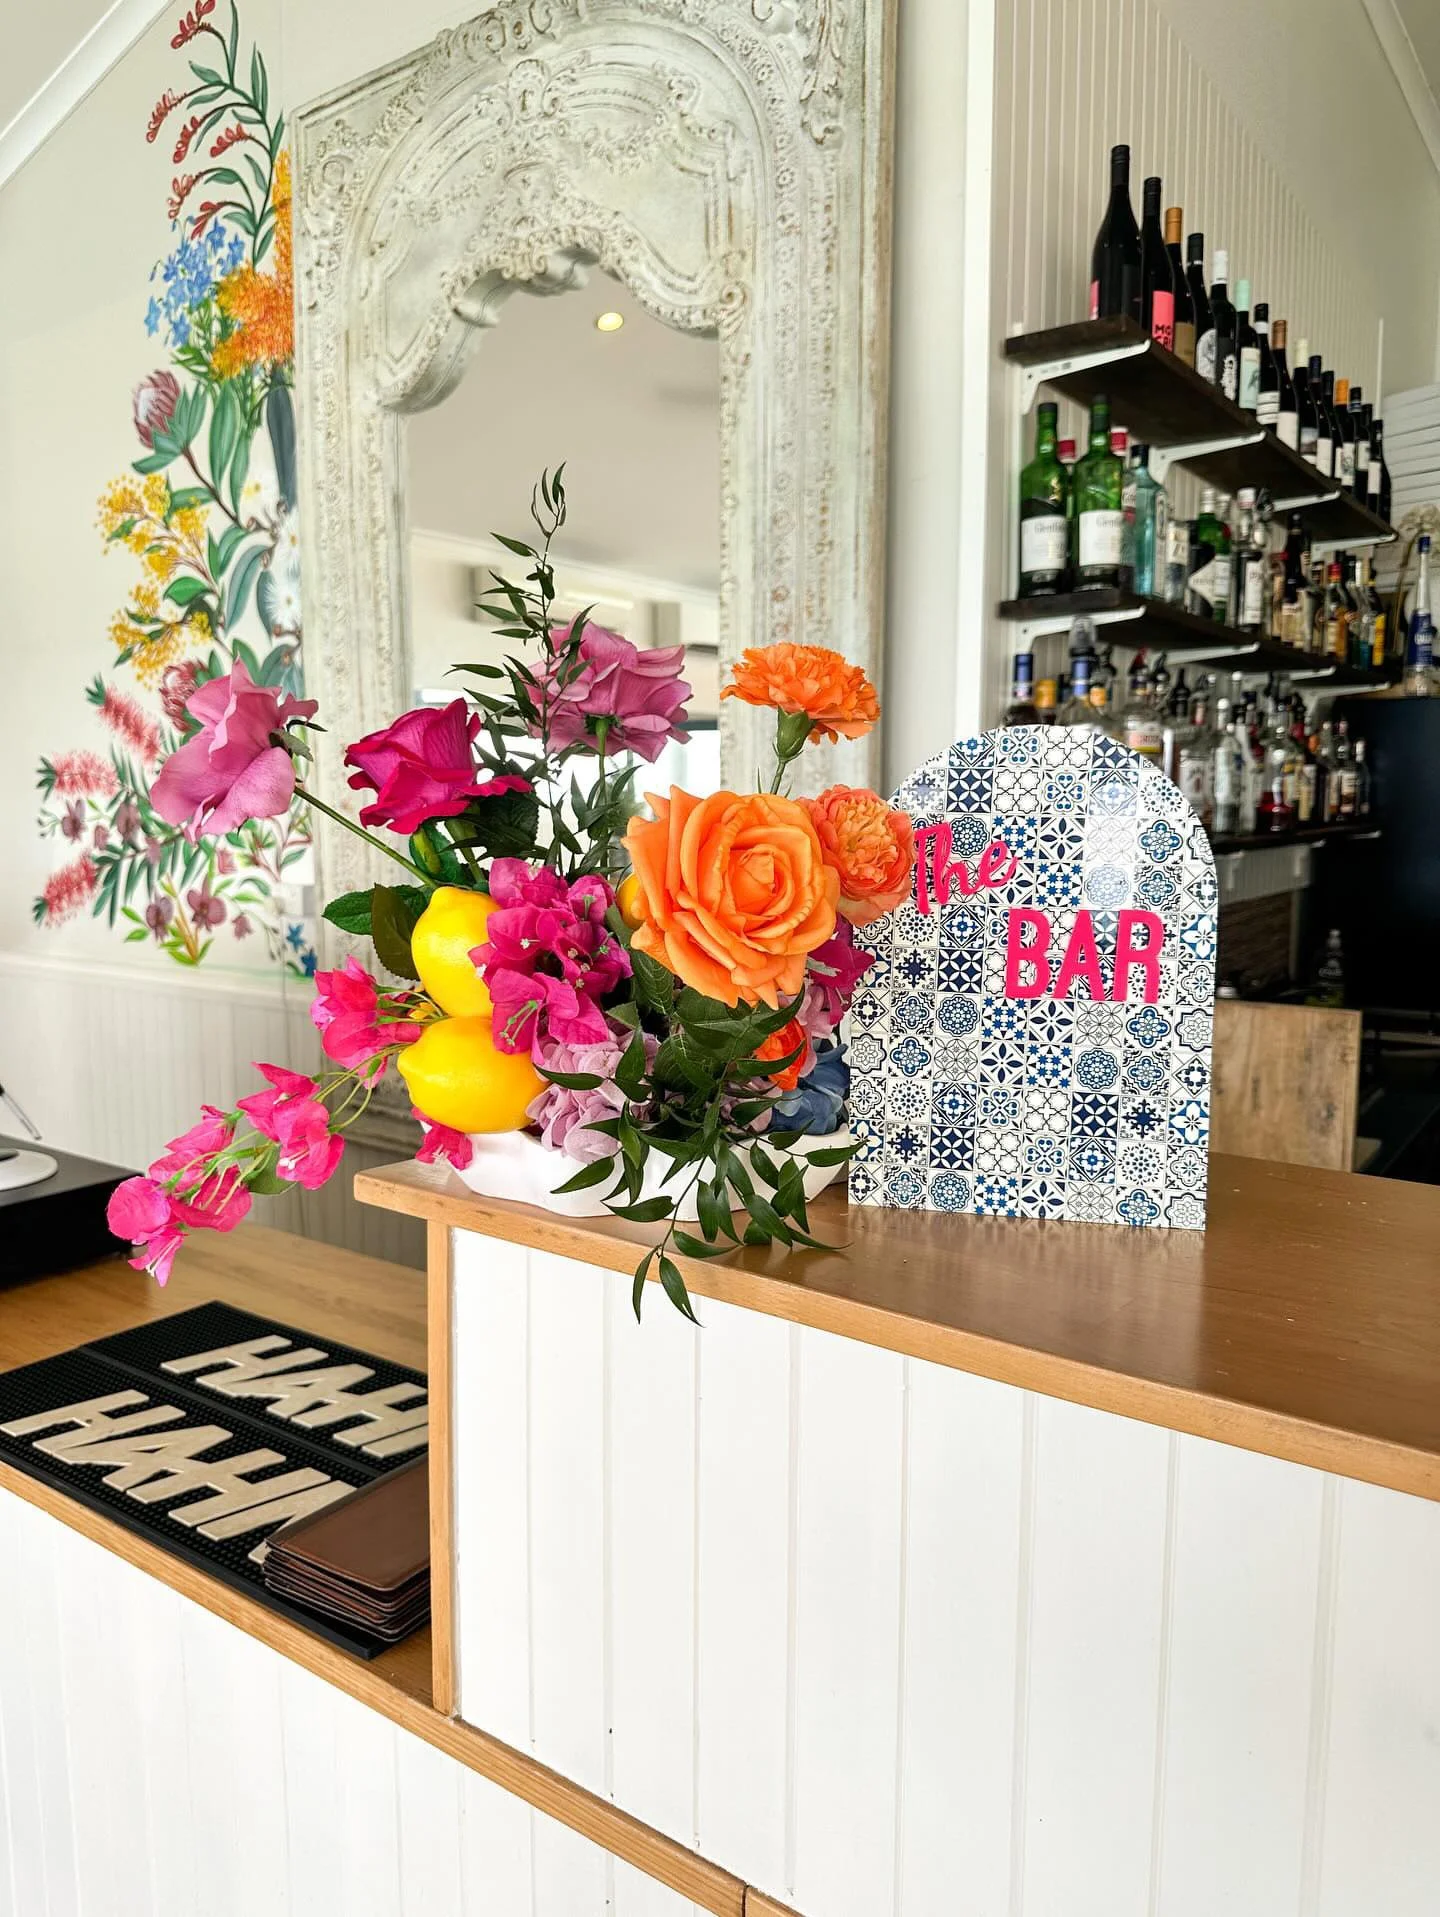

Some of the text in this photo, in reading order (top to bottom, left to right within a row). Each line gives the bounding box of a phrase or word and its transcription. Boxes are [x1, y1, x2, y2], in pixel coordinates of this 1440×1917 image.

[914, 822, 1018, 915] The
[1005, 908, 1164, 1003] BAR
[160, 1334, 429, 1457] HAH
